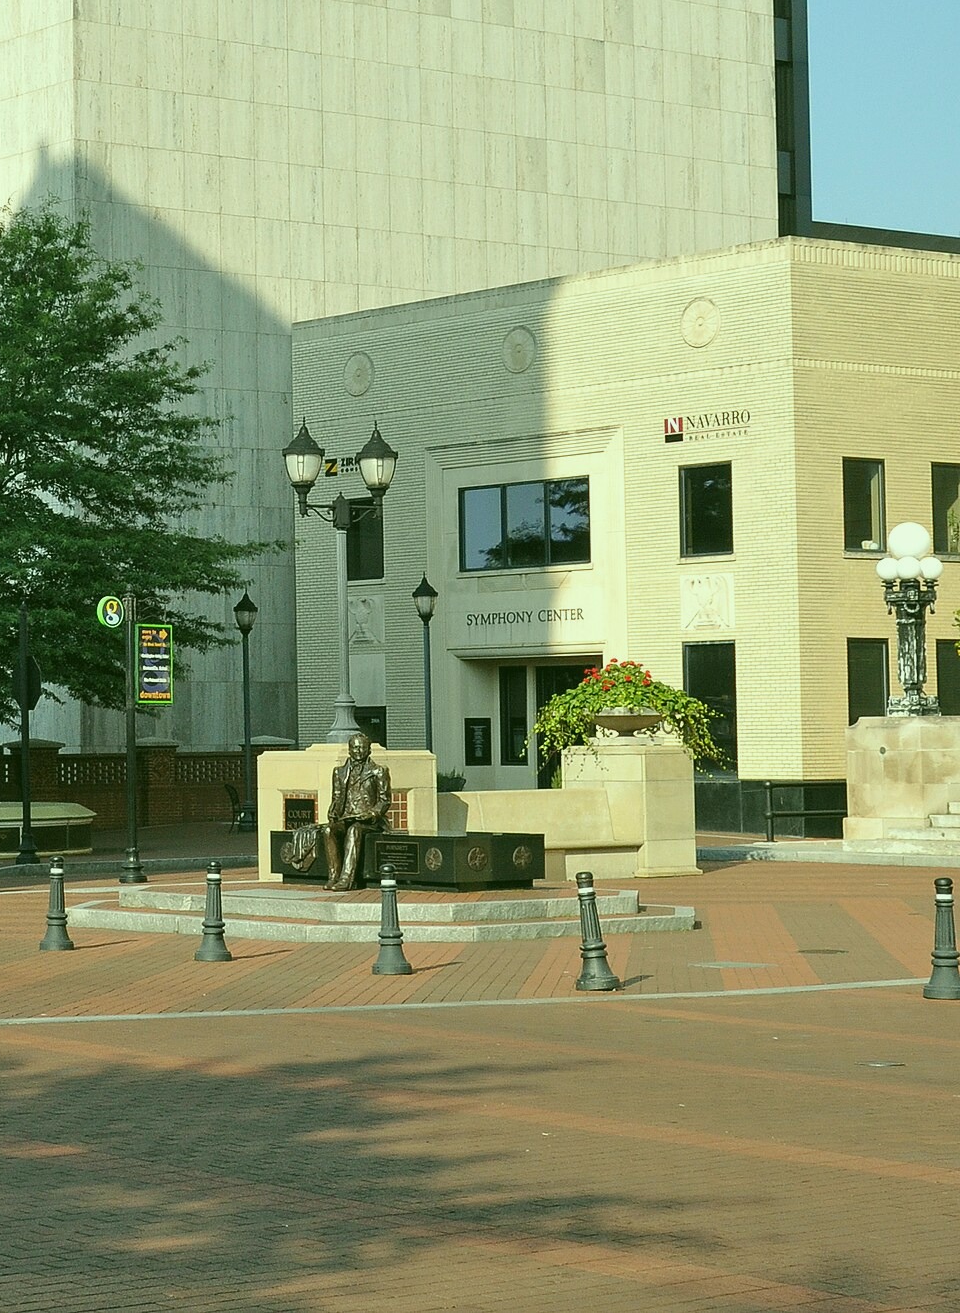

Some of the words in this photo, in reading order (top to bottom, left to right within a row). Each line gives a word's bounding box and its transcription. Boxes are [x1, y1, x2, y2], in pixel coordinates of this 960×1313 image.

[686, 409, 751, 430] NAVARRO
[688, 433, 711, 441] REAL
[715, 429, 748, 438] ESTATE
[466, 610, 533, 626] SYMPHONY
[538, 608, 584, 622] CENTER
[140, 691, 171, 699] downtown
[288, 810, 312, 819] COURT
